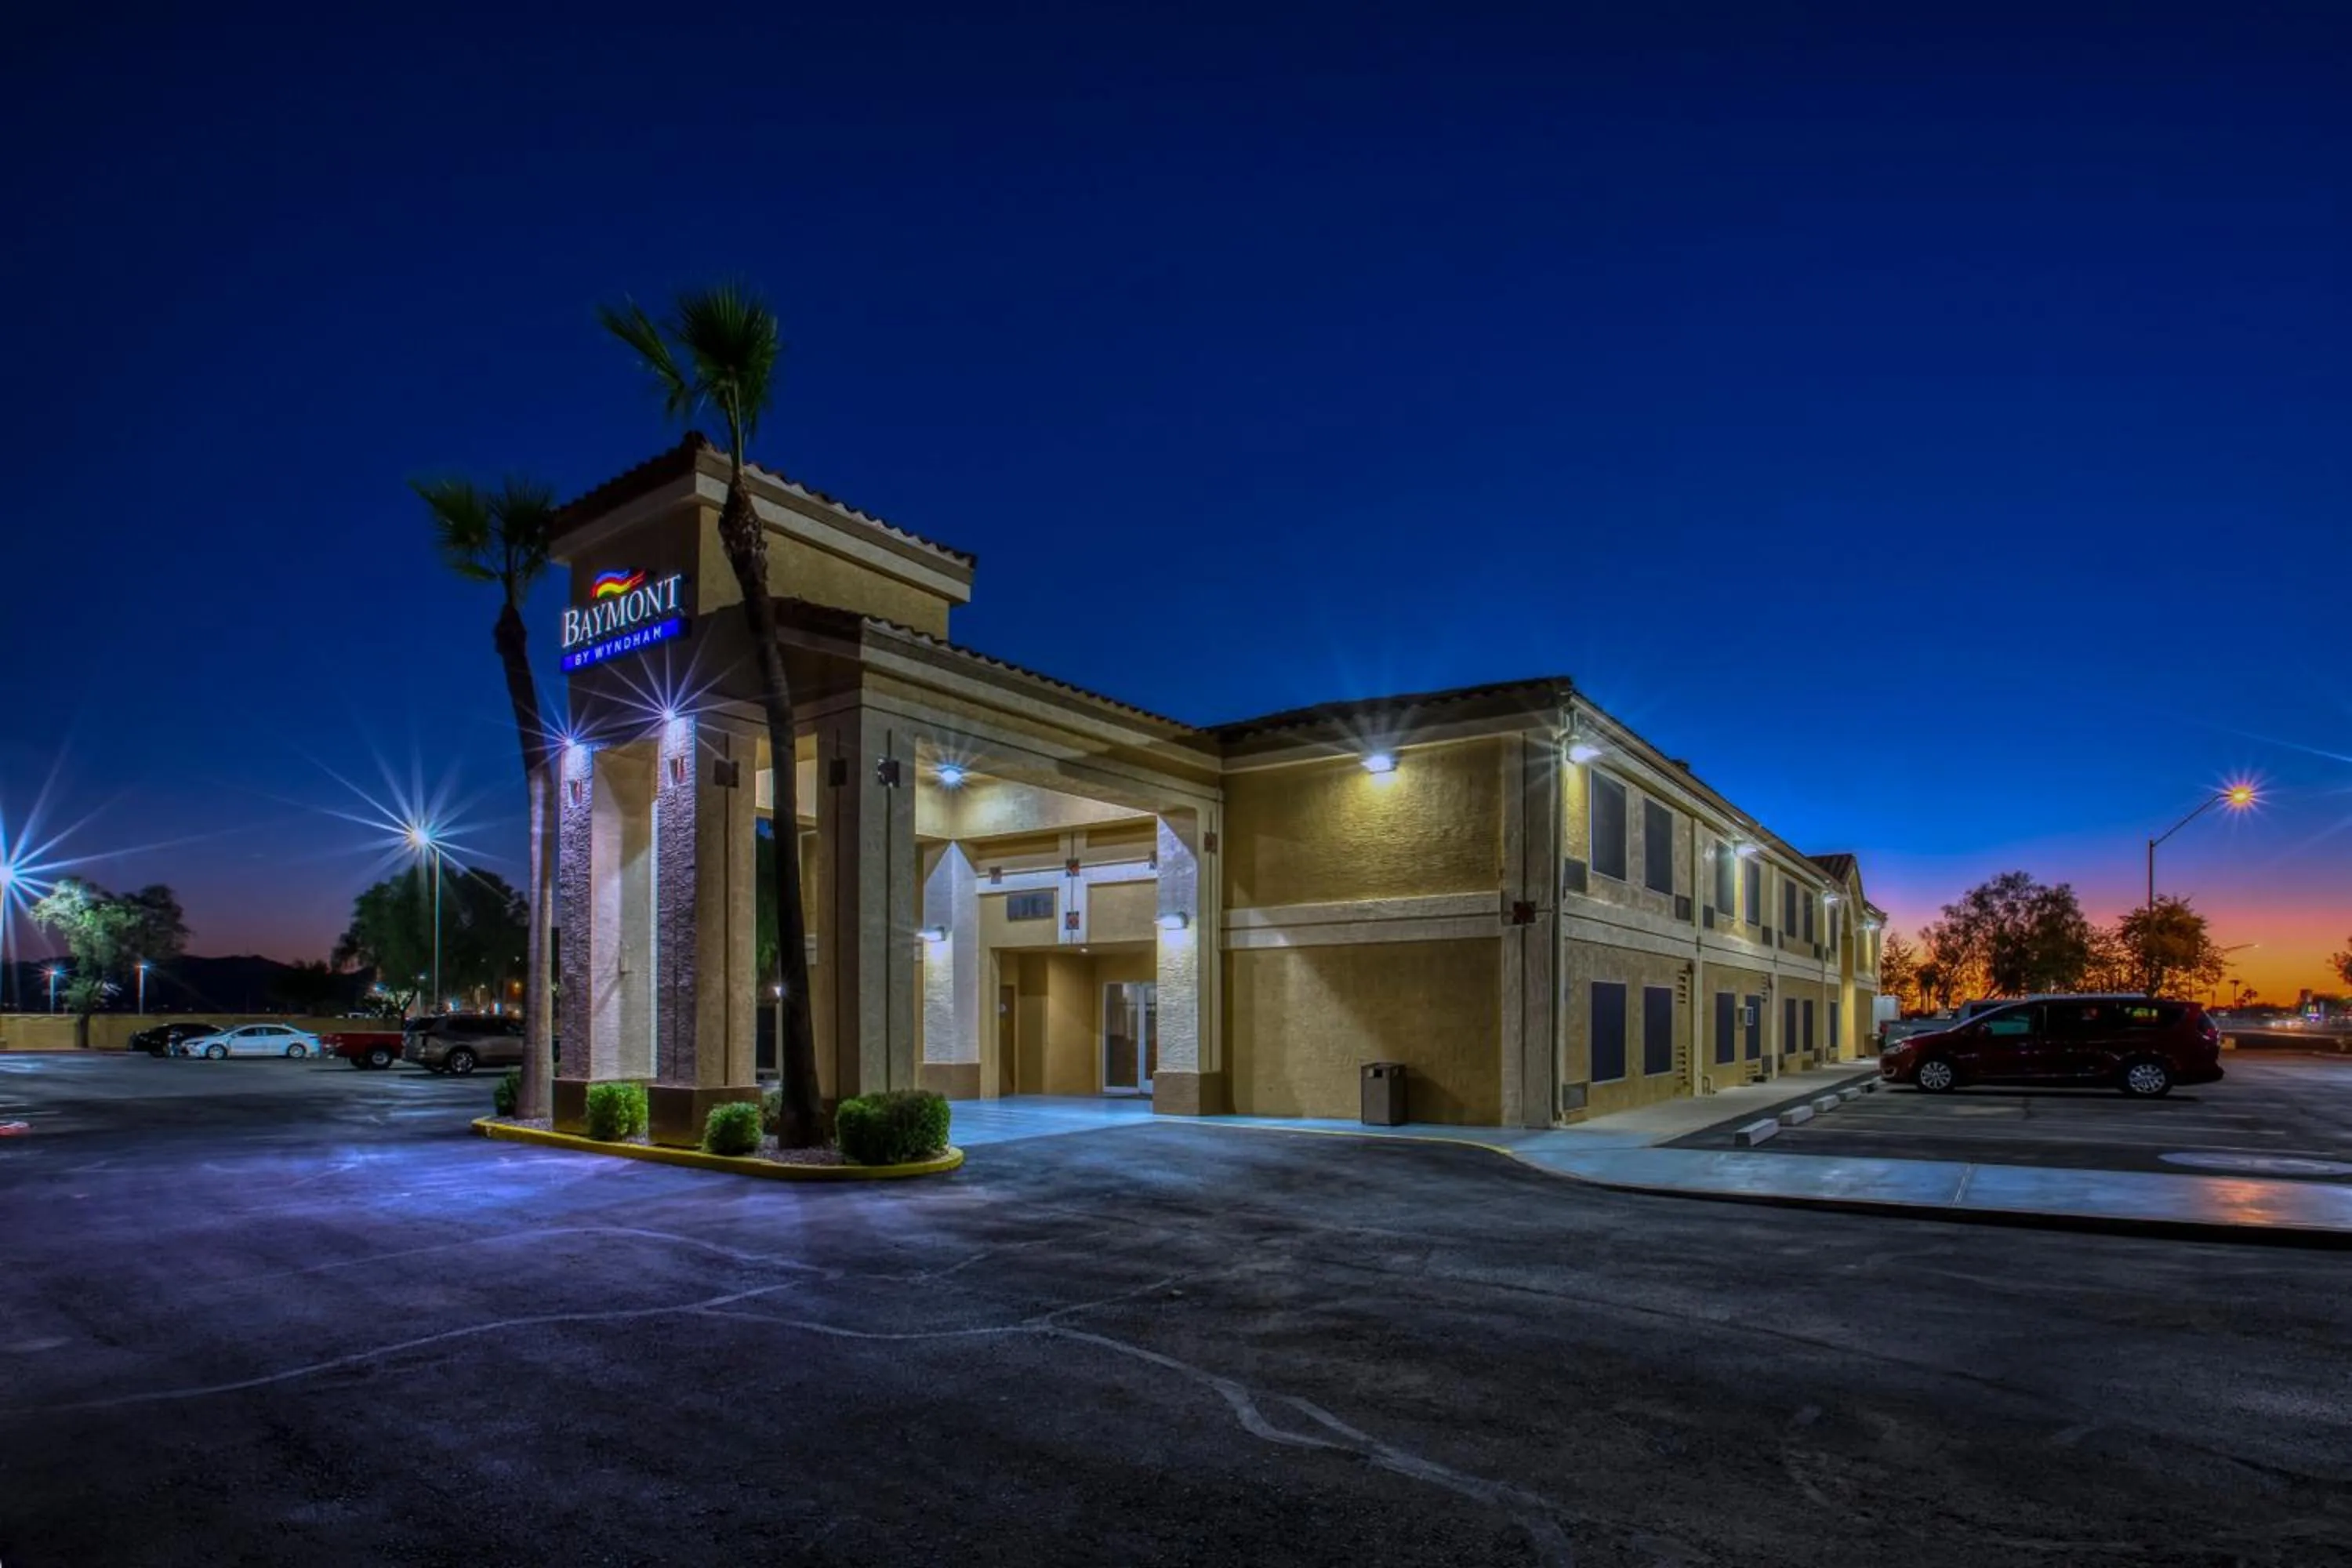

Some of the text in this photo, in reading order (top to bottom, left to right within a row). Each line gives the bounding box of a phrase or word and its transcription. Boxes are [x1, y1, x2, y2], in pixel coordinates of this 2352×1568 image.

[562, 574, 681, 648] BAYMONT
[575, 625, 662, 666] BY WYNDHAM
